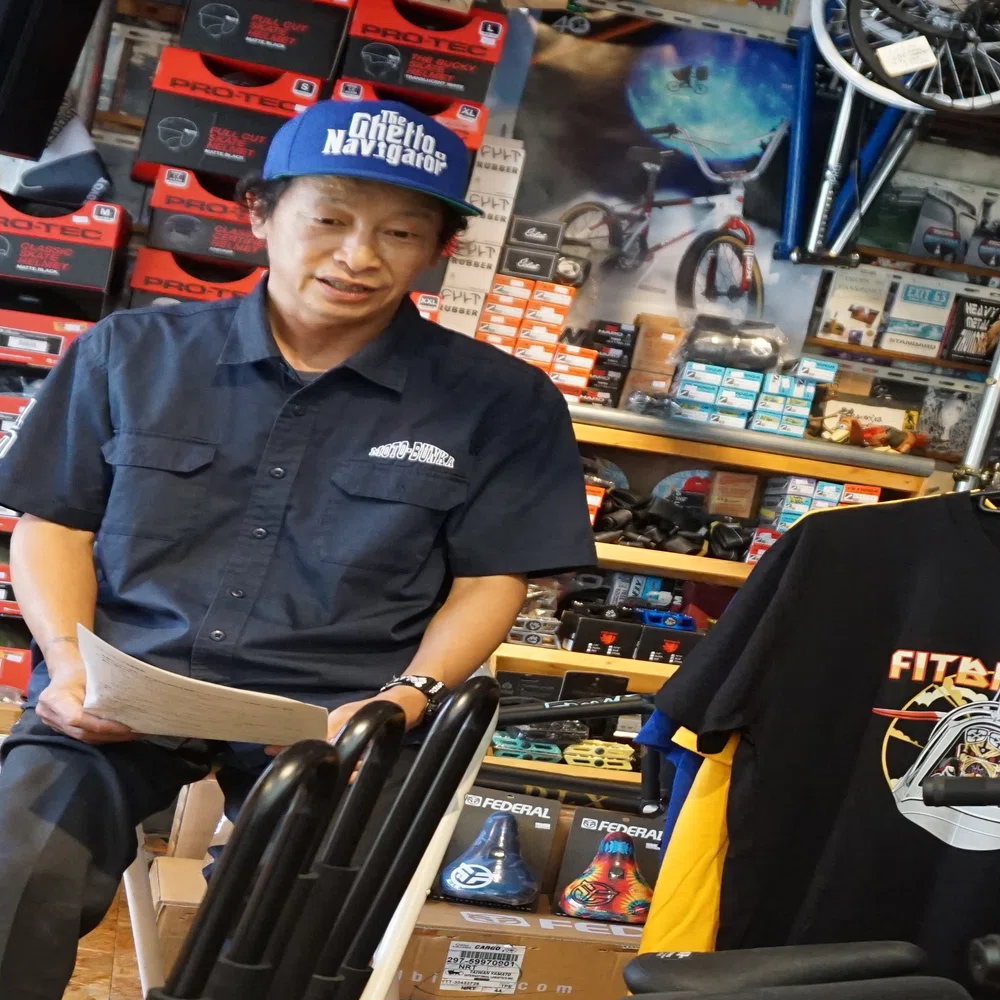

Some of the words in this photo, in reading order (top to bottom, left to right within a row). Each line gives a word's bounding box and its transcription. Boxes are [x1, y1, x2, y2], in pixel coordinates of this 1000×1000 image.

[361, 23, 488, 56] PRO-TEC
[169, 77, 297, 112] PRO-TEC
[380, 109, 407, 126] The
[348, 111, 437, 156] Ghetto
[321, 128, 448, 176] Navigator
[476, 160, 518, 174] RUBBER
[0, 216, 102, 241] RO-TEC
[143, 276, 248, 299] PRO-TE
[907, 287, 929, 301] EXIT
[933, 292, 947, 304] 63
[964, 302, 999, 318] HEAVY
[482, 797, 550, 819] FEDERAL
[598, 820, 664, 841] FEDERAL
